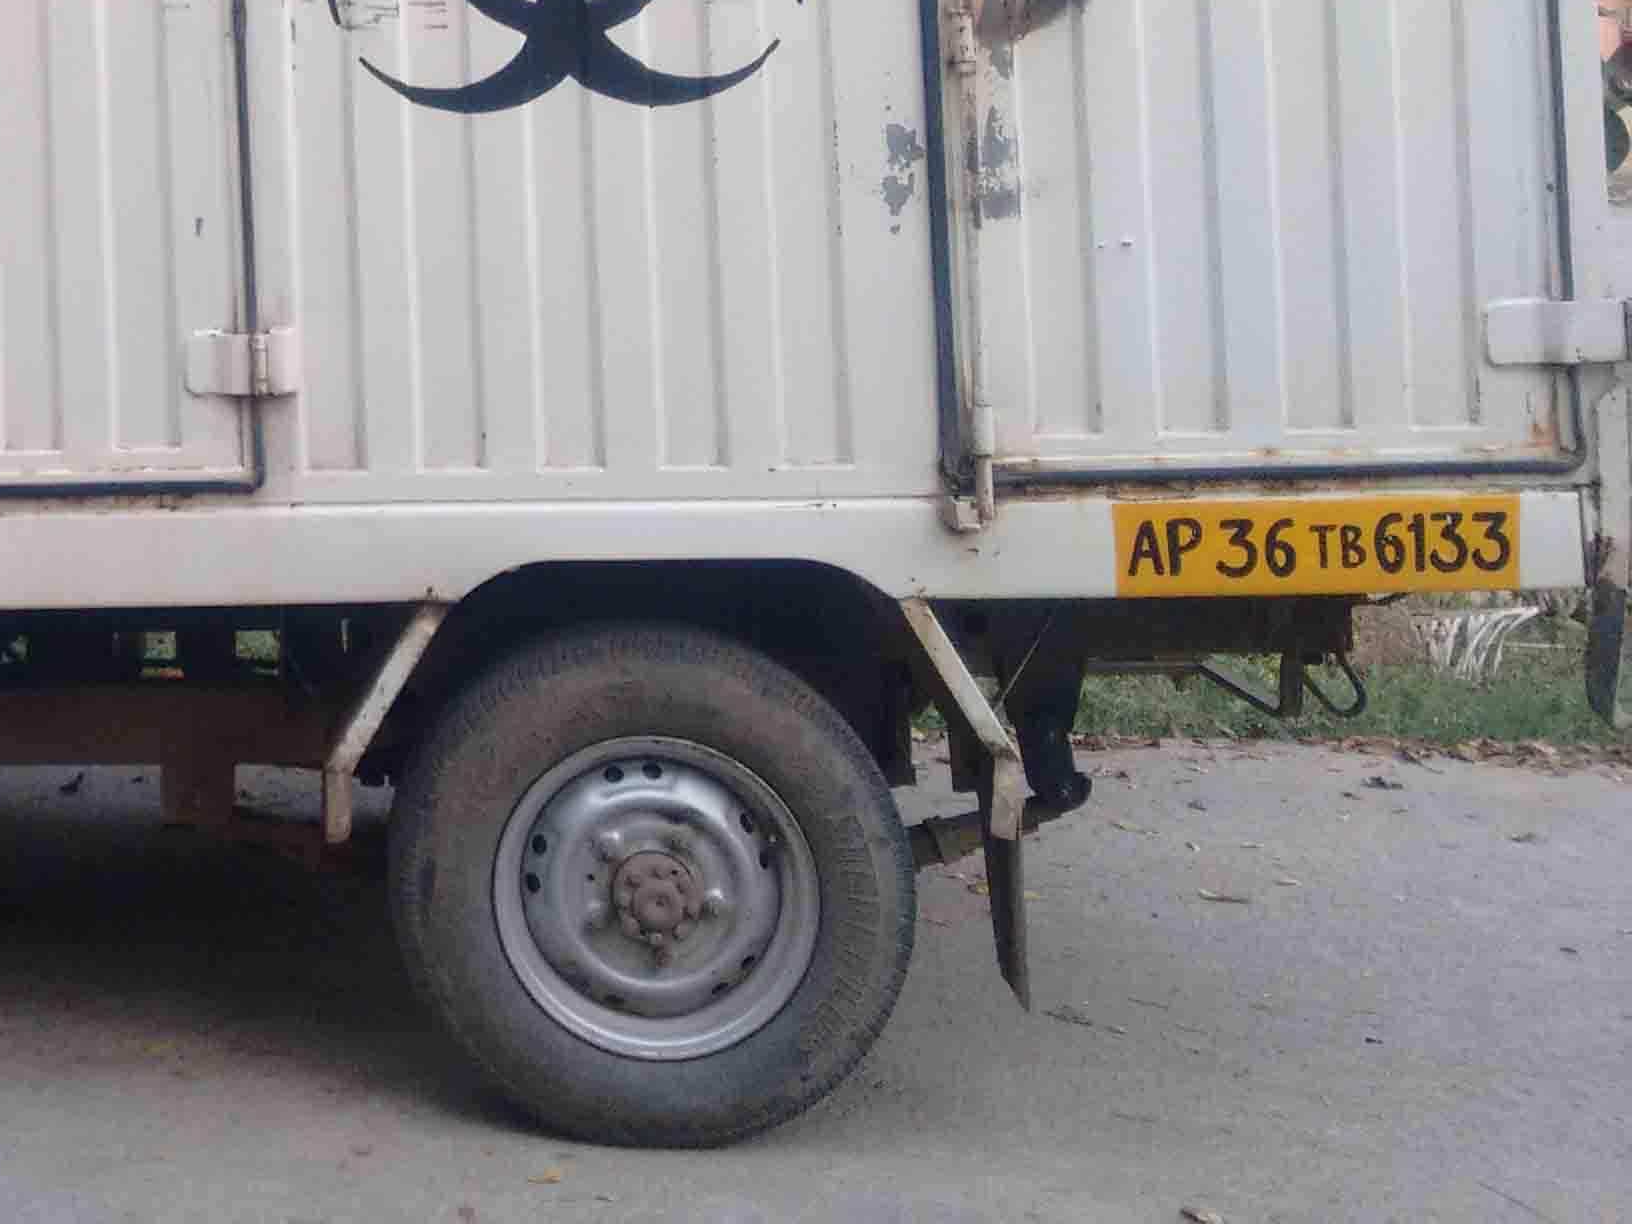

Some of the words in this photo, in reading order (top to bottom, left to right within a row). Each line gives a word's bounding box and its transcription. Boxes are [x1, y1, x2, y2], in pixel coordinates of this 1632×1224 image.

[1127, 517, 1203, 577] AP
[1216, 518, 1298, 577] 36
[1373, 511, 1511, 574] 6133
